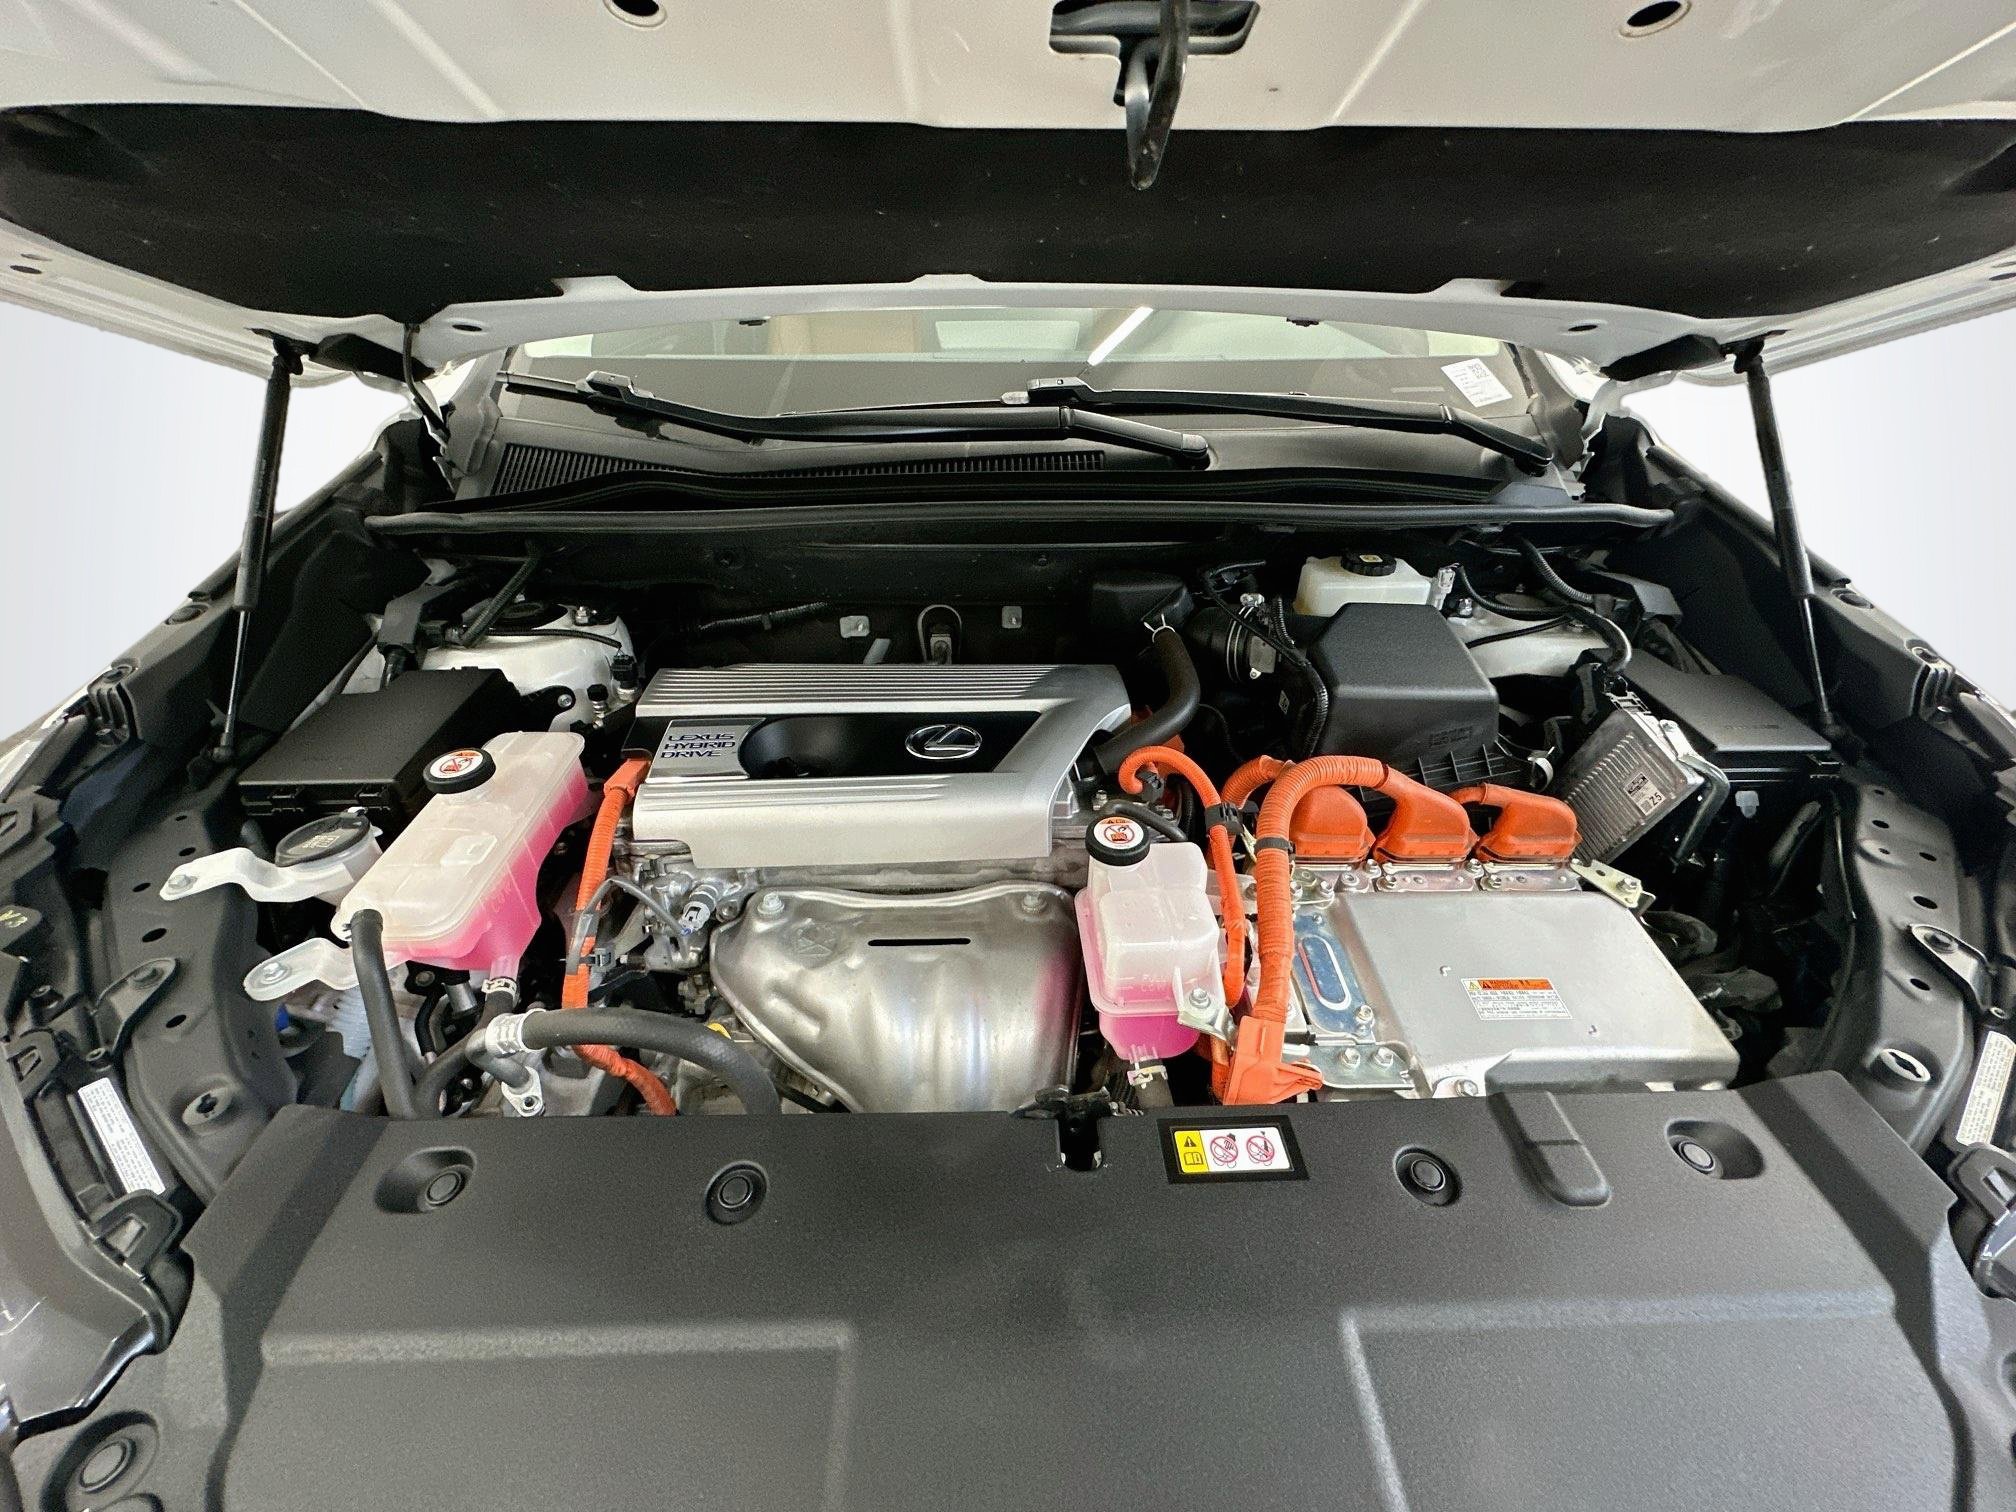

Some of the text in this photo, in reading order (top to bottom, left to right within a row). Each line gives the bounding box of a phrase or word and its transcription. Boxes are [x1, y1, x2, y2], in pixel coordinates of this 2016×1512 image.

[667, 733, 735, 742] LEXUS
[663, 740, 737, 750] HYBRID
[660, 749, 723, 759] DRIVE
